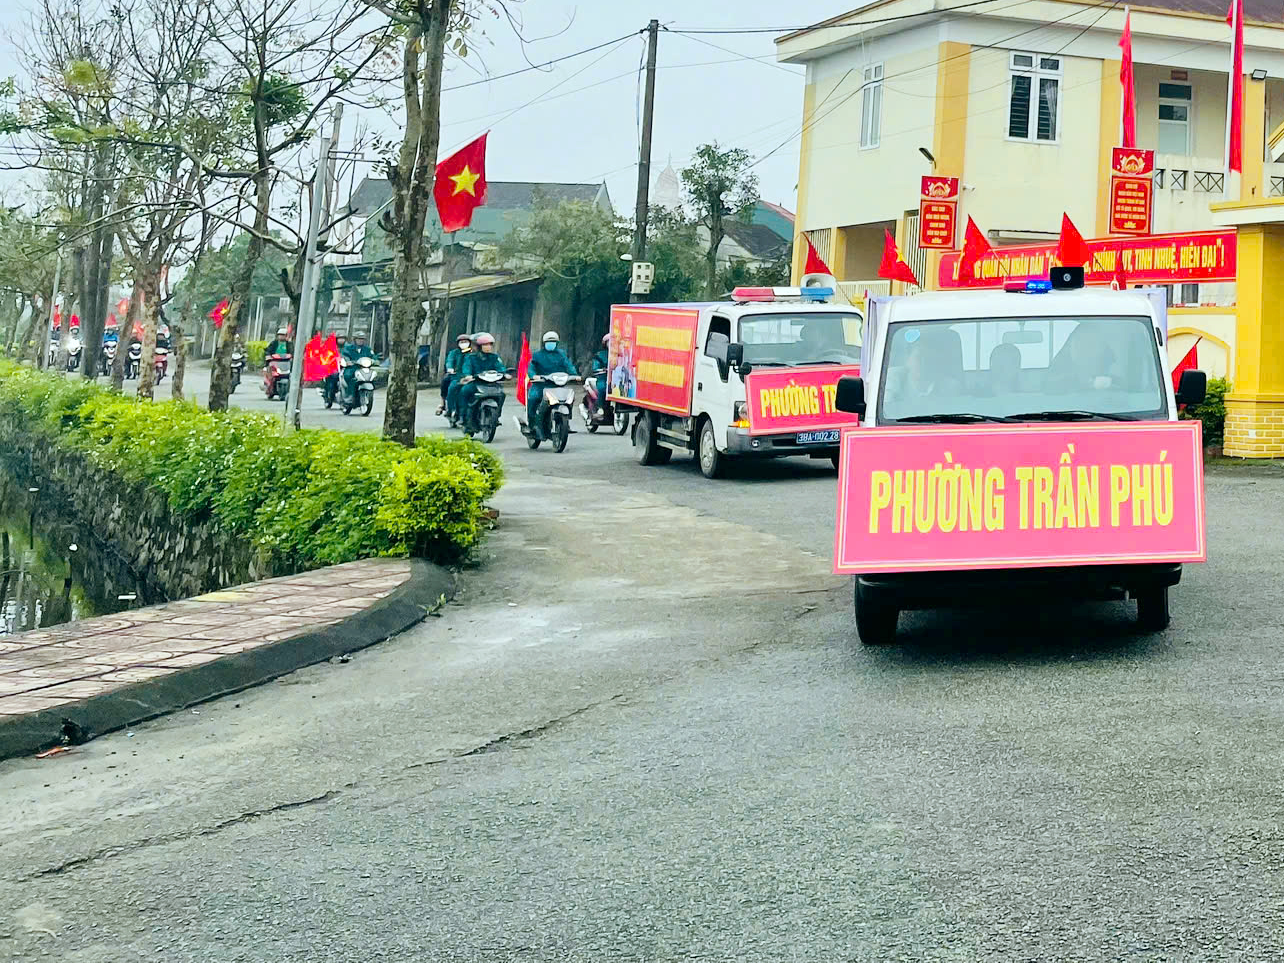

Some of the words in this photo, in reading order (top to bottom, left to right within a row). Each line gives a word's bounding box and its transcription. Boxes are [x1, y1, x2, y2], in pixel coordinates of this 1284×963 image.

[1180, 240, 1200, 274] HIỆN
[760, 379, 820, 418] PHƯỜNG
[868, 451, 1005, 534] PHƯỜNG
[1015, 443, 1100, 530] TRẦN
[1110, 450, 1175, 527] PHÚ
